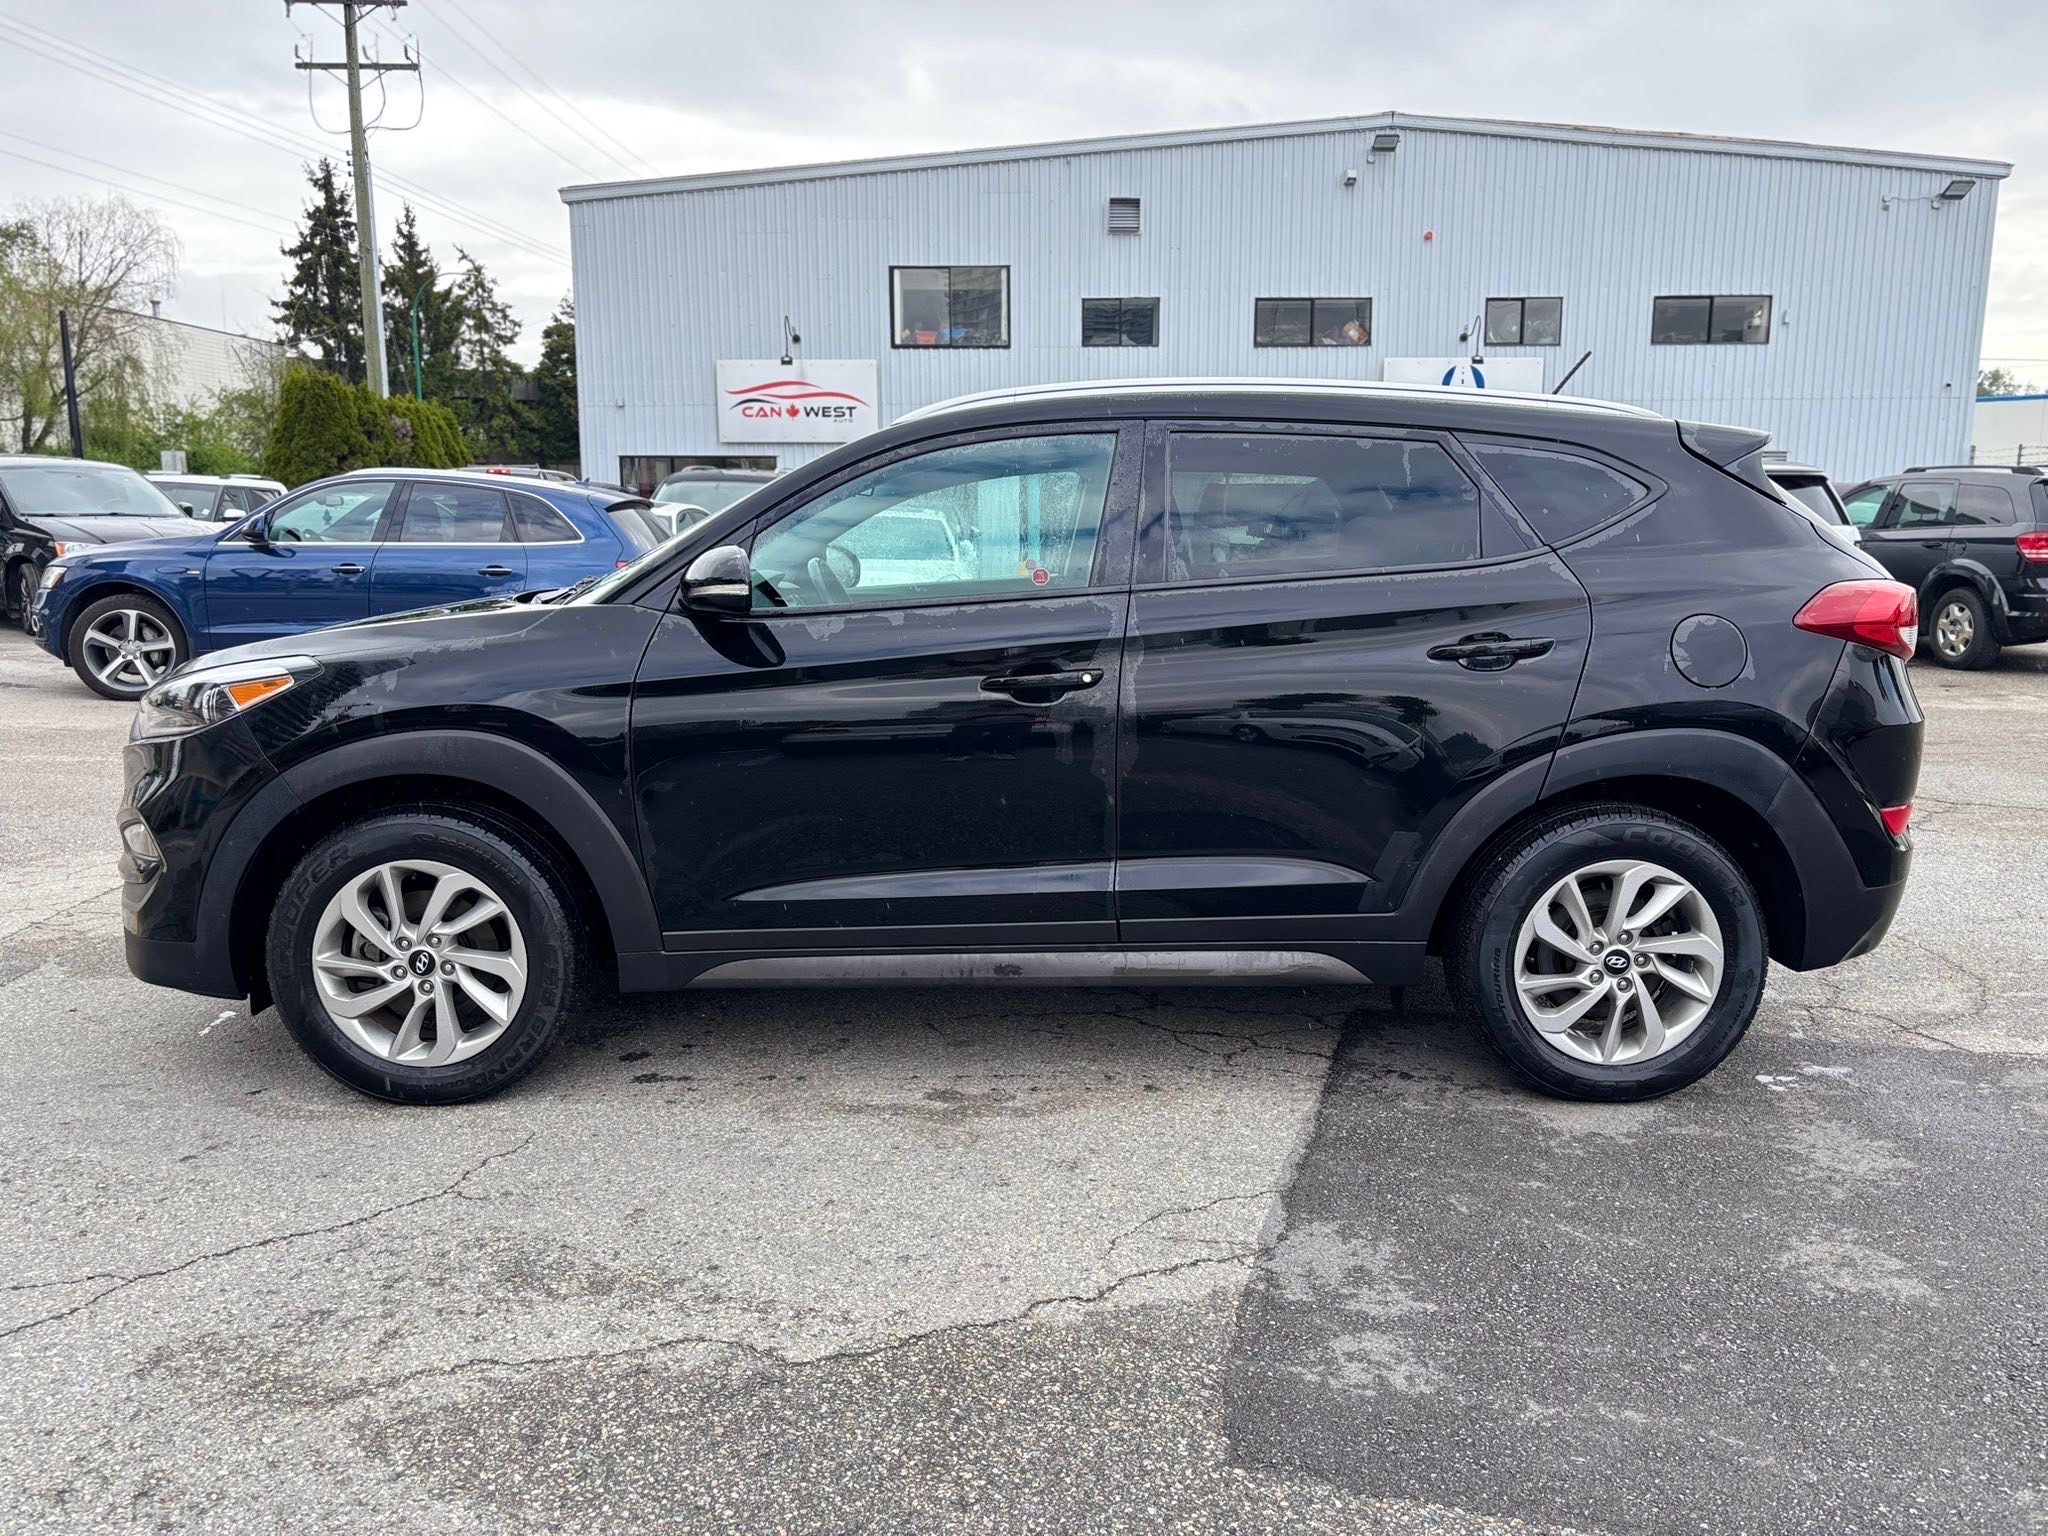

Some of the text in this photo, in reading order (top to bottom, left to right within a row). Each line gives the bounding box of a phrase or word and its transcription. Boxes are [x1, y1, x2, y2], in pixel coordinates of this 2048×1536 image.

[742, 406, 857, 417] CAN WEST
[1623, 827, 1746, 907] COOPER
[279, 844, 349, 972] COOPER
[1492, 946, 1504, 1009] TOURING
